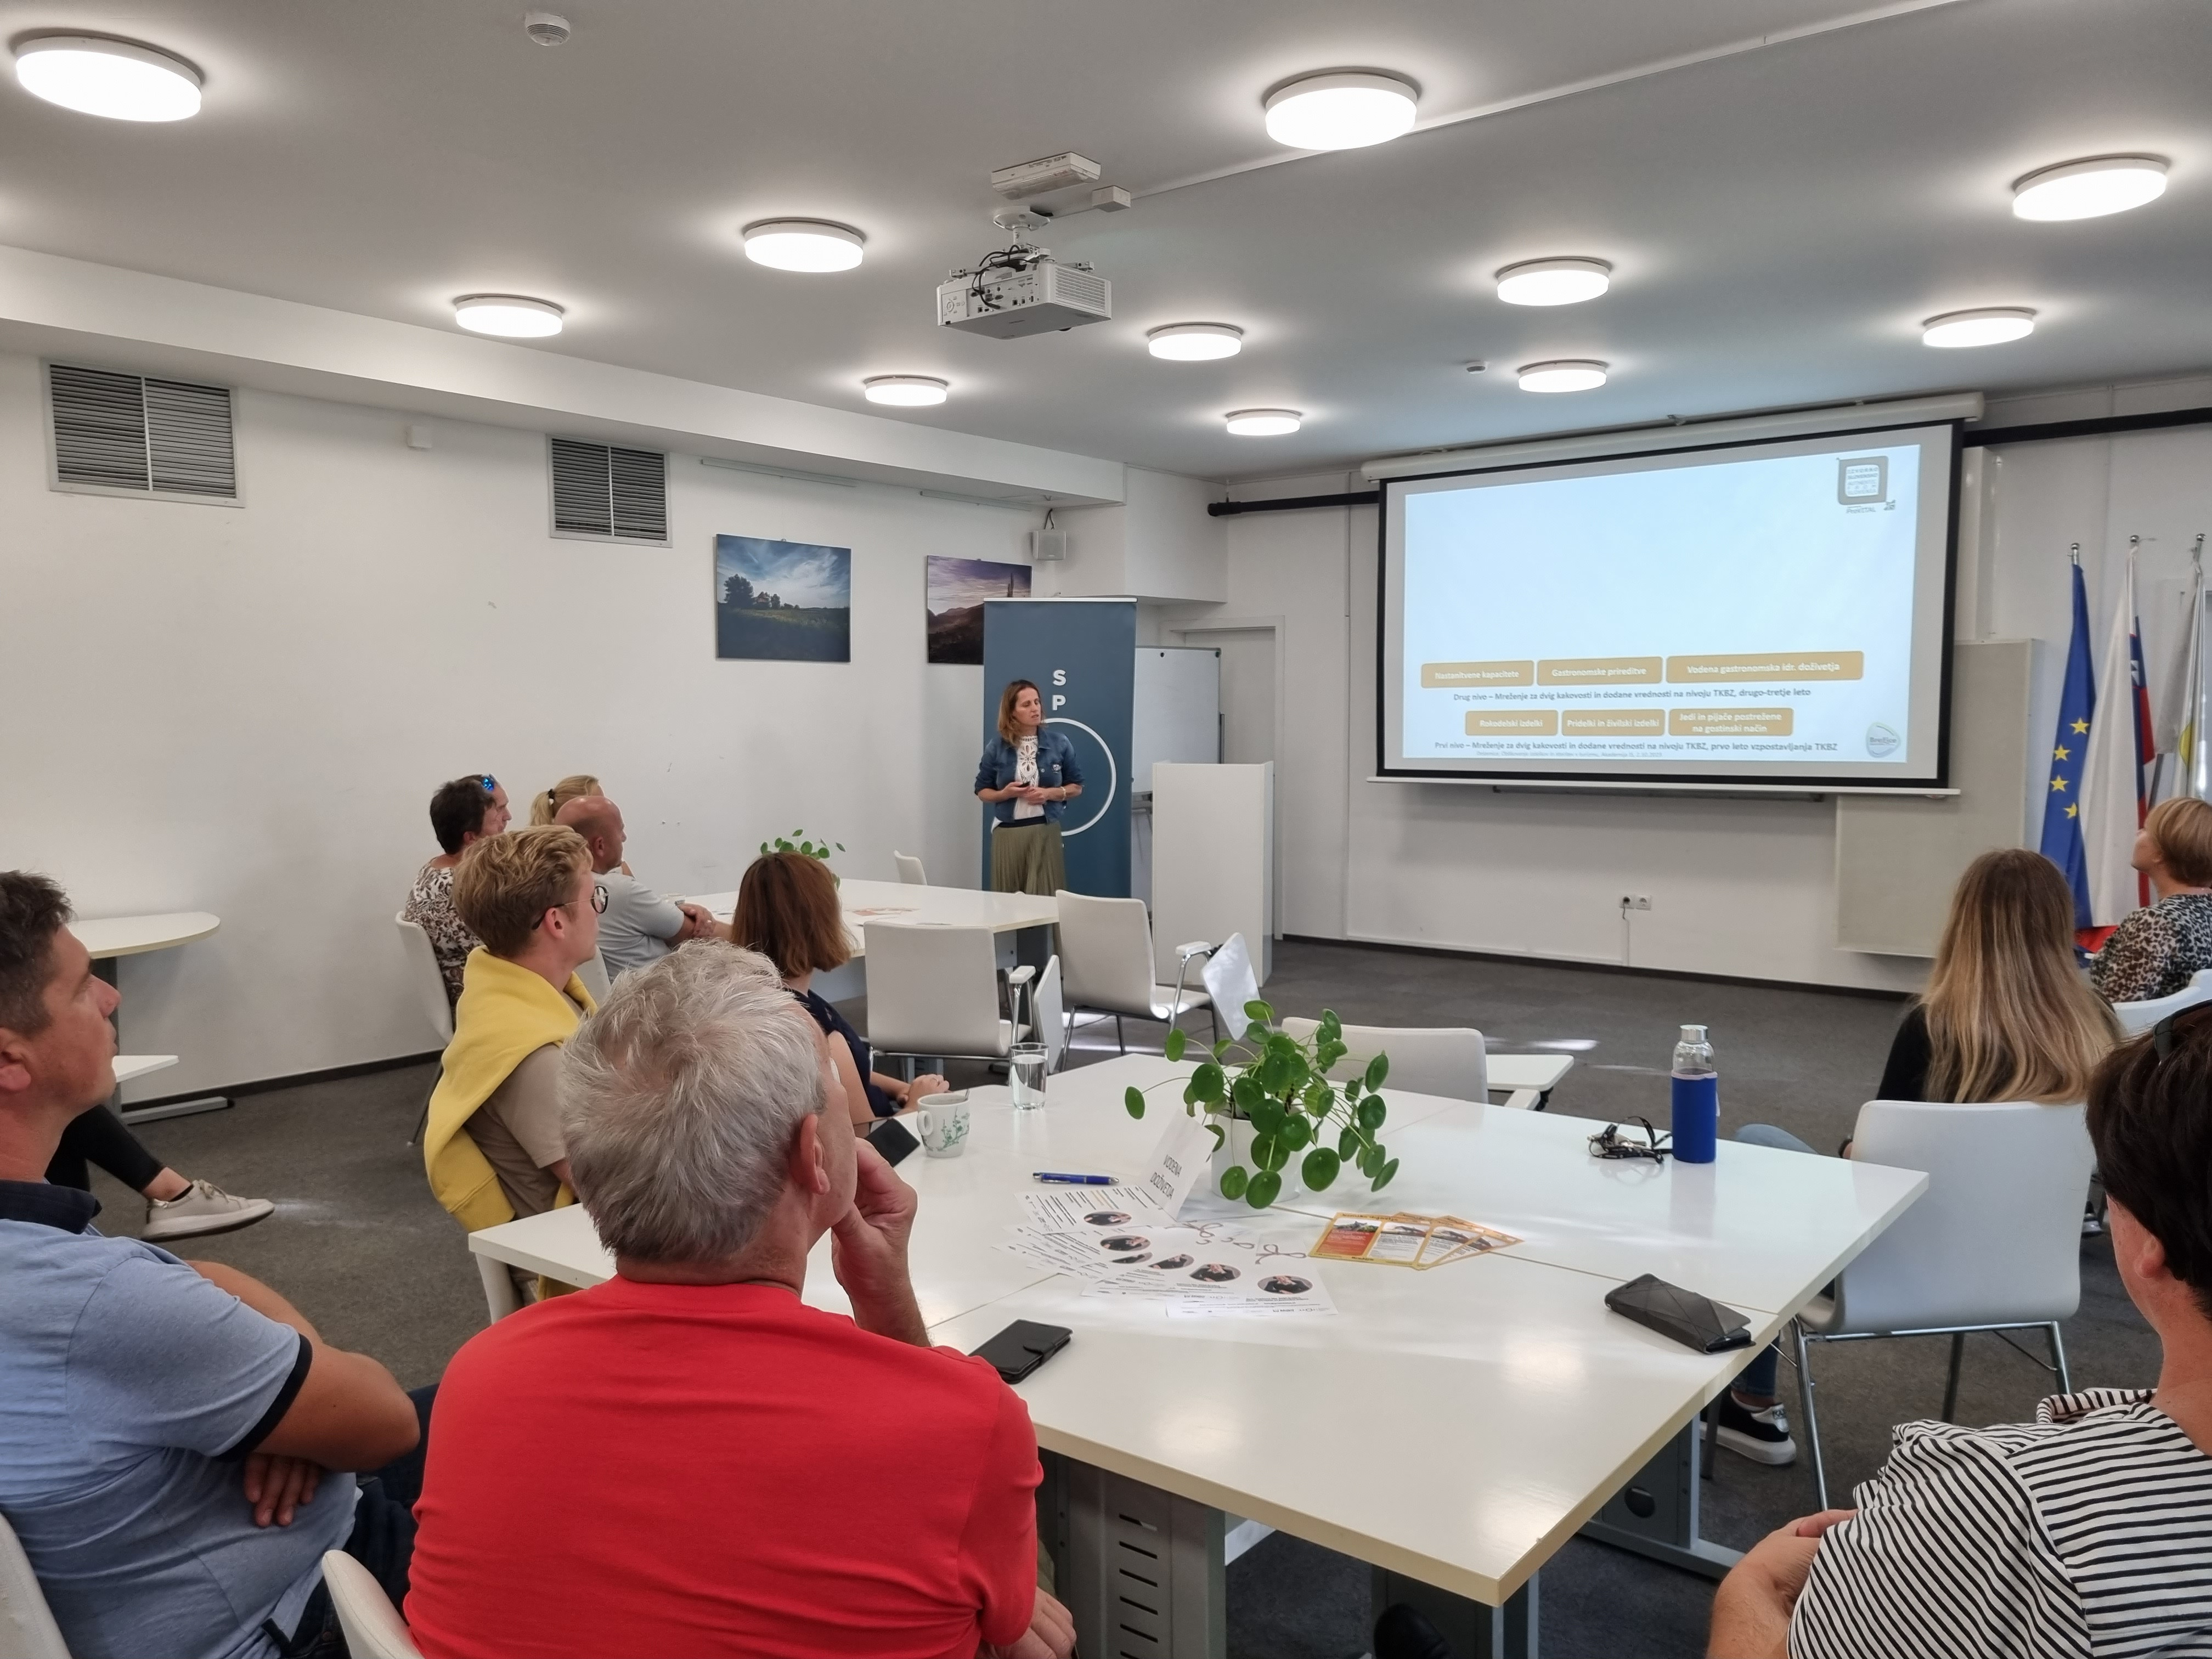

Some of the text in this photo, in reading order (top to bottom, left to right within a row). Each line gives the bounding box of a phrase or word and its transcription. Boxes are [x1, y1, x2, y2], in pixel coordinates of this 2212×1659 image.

[1551, 667, 1647, 676] Gastronomske prireditve
[1687, 665, 1719, 674] Vodena
[1720, 663, 1780, 674] gastronomska
[1798, 662, 1840, 672] doživetja
[1482, 670, 1520, 679] kapacitete
[1454, 693, 1470, 702] Drug
[1495, 692, 1528, 701] Mreženje
[1540, 692, 1555, 700] dvig
[1634, 690, 1672, 698] vrednosti
[1686, 690, 1711, 698] nivoju
[1739, 688, 1791, 698] drugo-tretje
[1793, 688, 1811, 696] leto
[1708, 713, 1733, 722] pijače
[1735, 712, 1782, 722] postrežene
[1520, 719, 1543, 727] izdelki
[1567, 719, 1659, 727] Pridelki in živilski izdelki
[1705, 724, 1742, 733] gostinski
[1744, 724, 1767, 732] način
[1472, 741, 1505, 751] Mreženje
[1515, 742, 1531, 751] dvig
[1659, 742, 1684, 751] nivoju
[1751, 743, 1812, 752] vzpostavljanja
